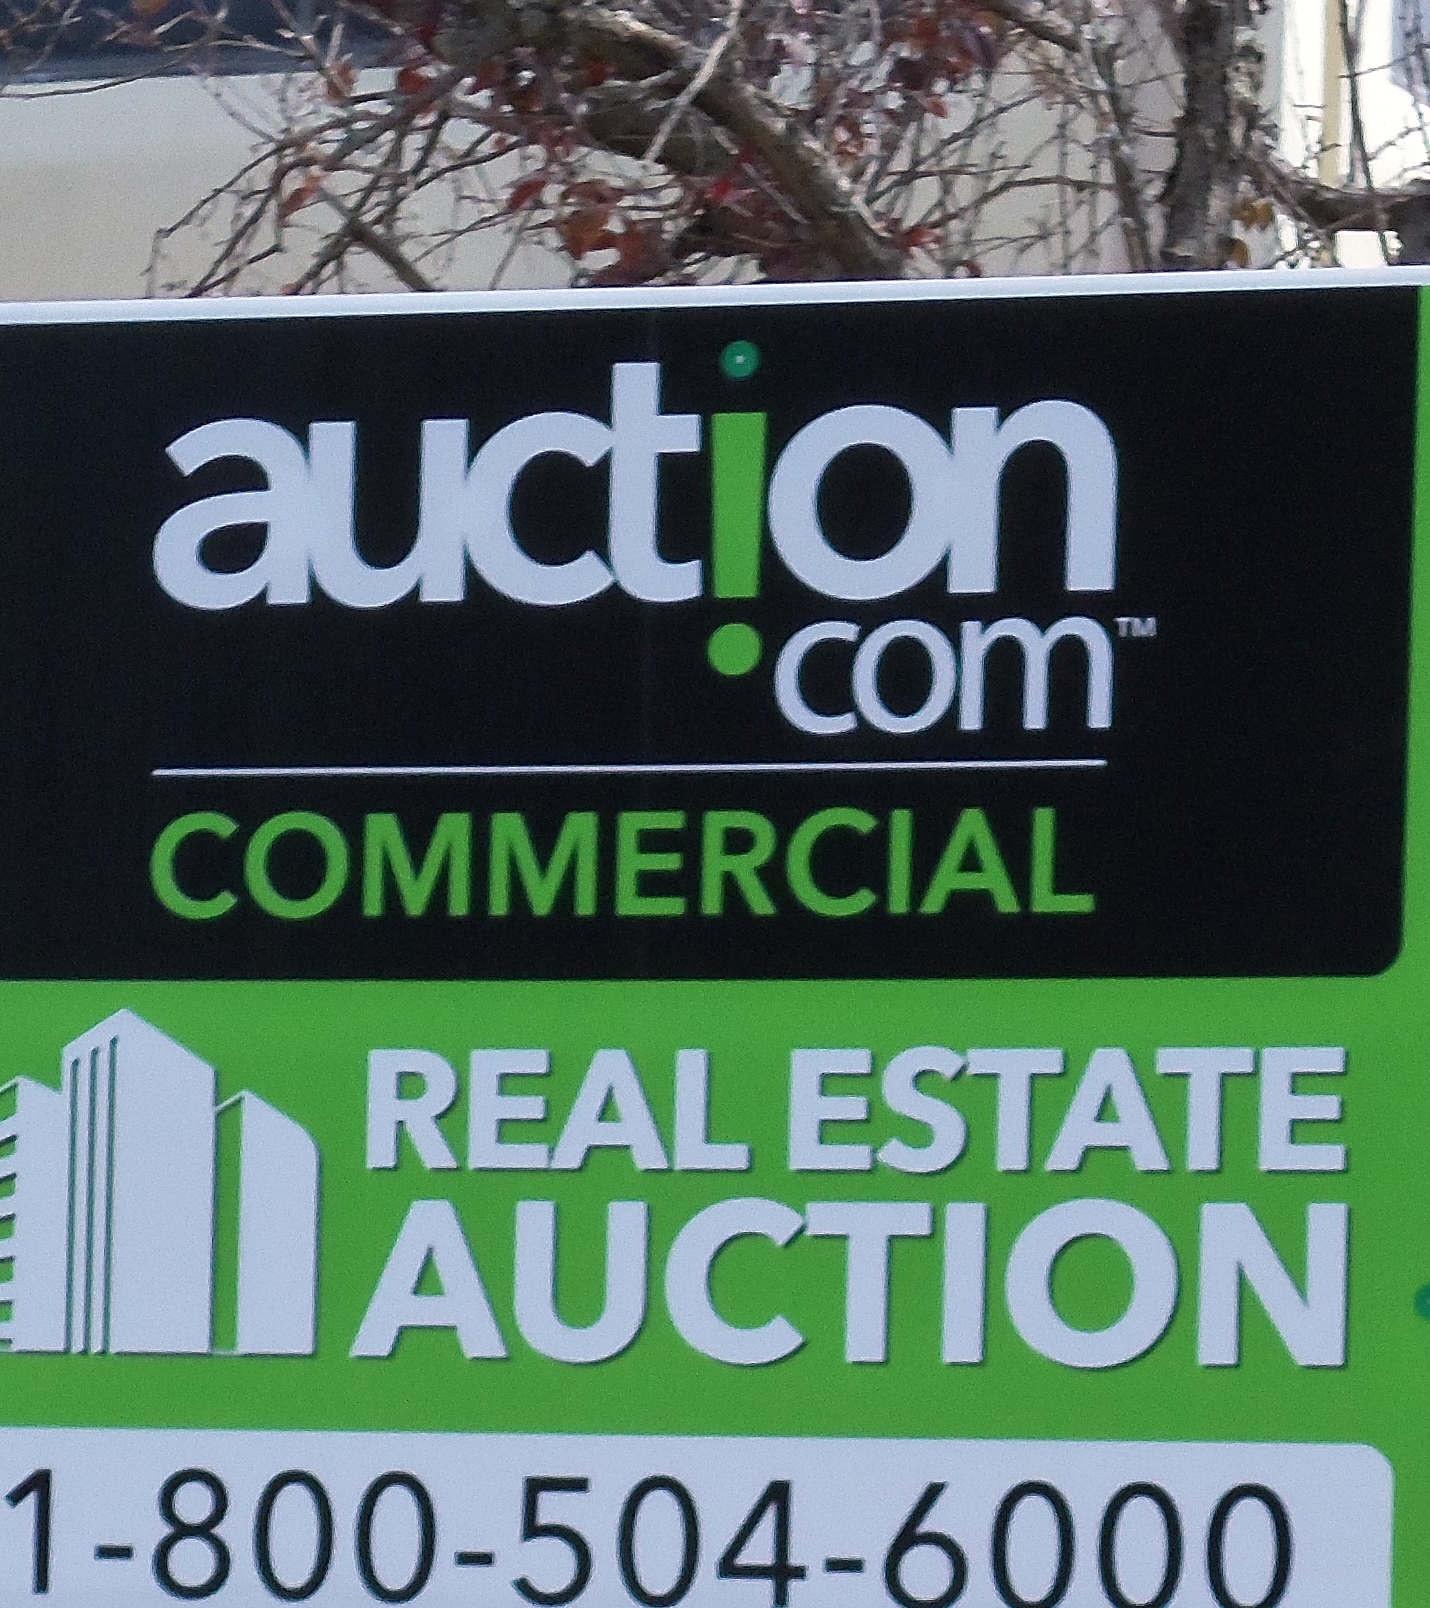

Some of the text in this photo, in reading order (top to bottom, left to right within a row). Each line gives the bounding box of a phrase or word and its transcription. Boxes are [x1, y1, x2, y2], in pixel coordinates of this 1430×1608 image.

[152, 361, 1118, 610] auction
[150, 806, 1095, 921] COMMERCIAL
[365, 1045, 1347, 1174] REAL ESTATE
[348, 1196, 1348, 1370] AUCTION
